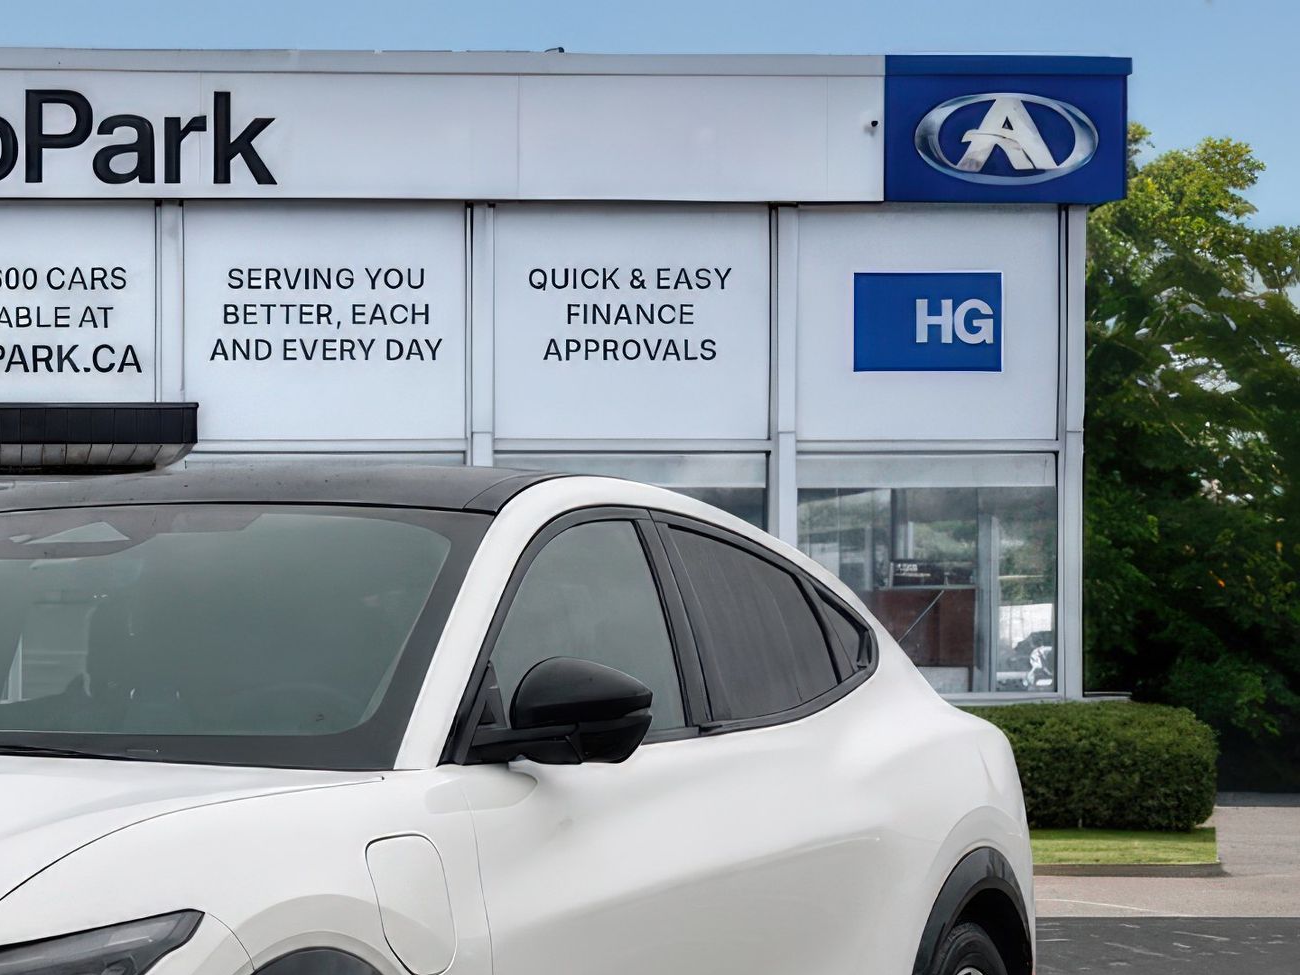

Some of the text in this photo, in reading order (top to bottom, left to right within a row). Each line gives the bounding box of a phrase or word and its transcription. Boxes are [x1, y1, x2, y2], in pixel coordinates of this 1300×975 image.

[46, 266, 127, 291] CARS
[227, 267, 425, 290] SERVING YOU
[528, 267, 732, 291] QUICK & EASY
[78, 305, 114, 329] AT
[223, 303, 429, 330] BETTER, EACH
[567, 303, 694, 326] FINANCE
[915, 298, 994, 345] HG
[209, 338, 443, 361] AND EVERY DAY
[543, 338, 717, 362] APPROVALS
